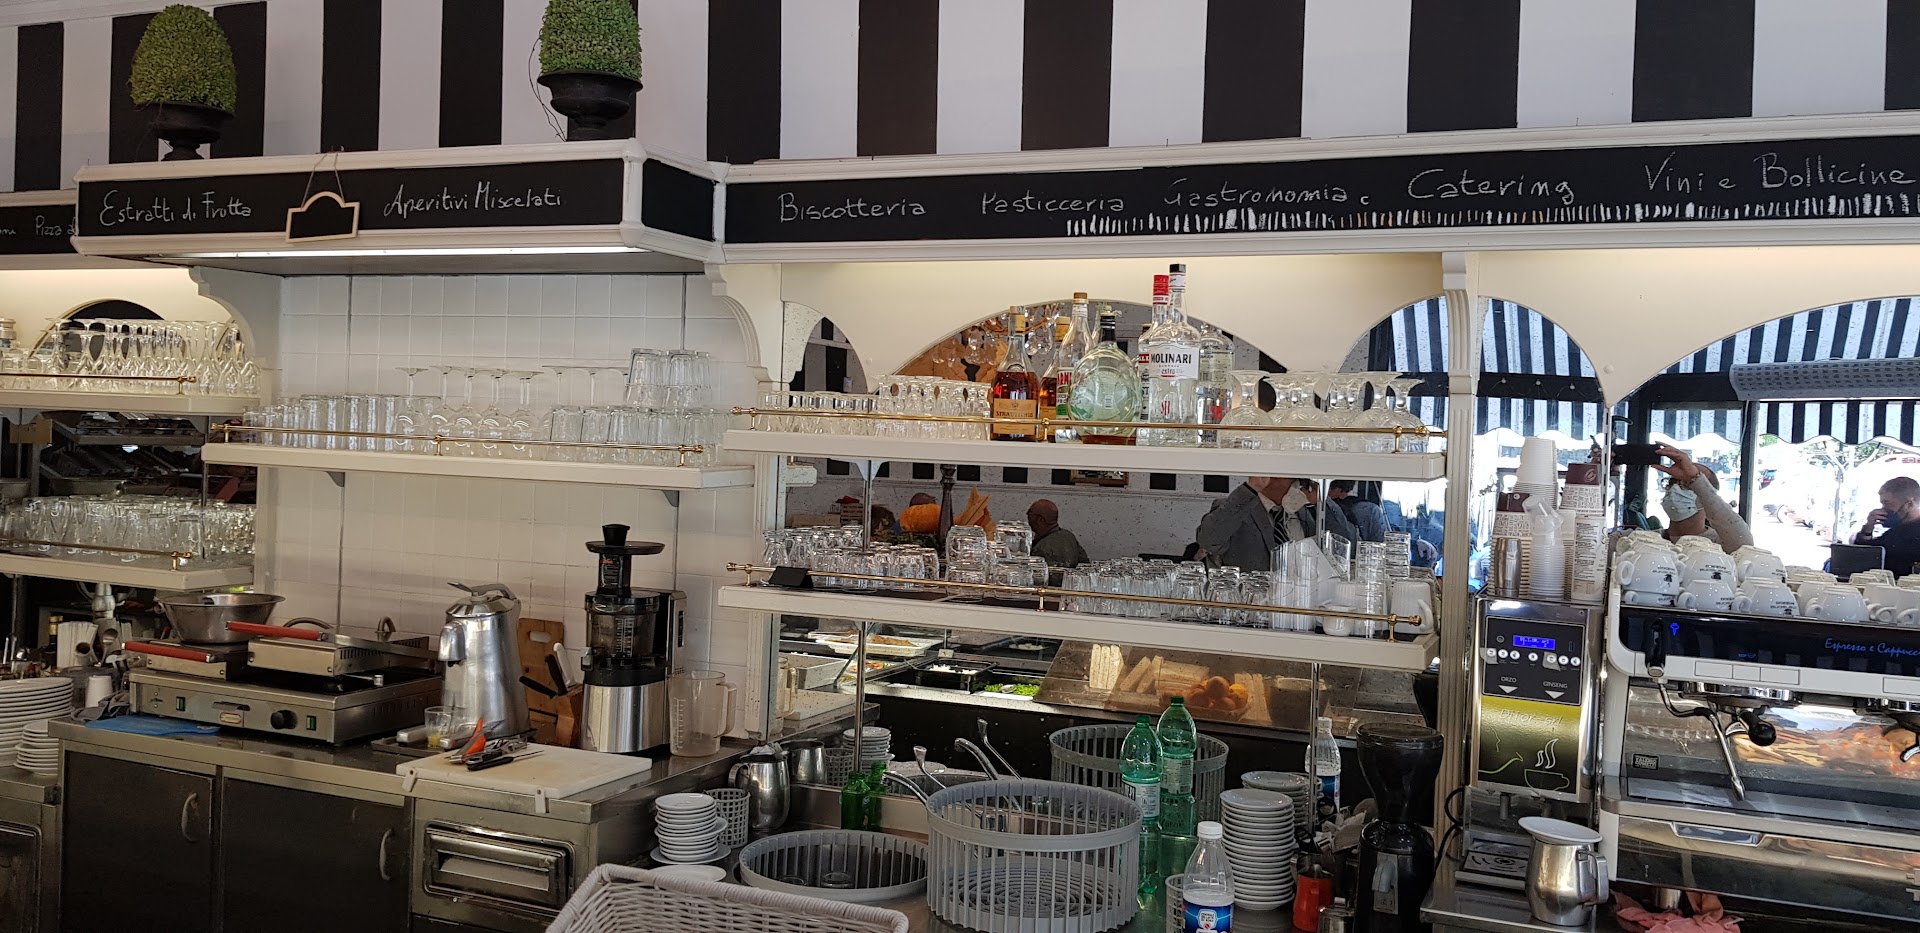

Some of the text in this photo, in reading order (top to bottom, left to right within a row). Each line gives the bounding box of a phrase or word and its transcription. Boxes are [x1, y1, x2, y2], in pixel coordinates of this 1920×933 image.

[1645, 152, 1916, 193] Vini e Bollicine
[100, 189, 251, 226] Estratti di Frutta
[384, 181, 561, 219] Aperitivi Miscelati
[778, 192, 926, 223] Biscotteria
[981, 189, 1125, 214] Pasticceria
[1408, 168, 1575, 205] Catering
[35, 215, 62, 236] Pizza
[1150, 353, 1192, 364] MOLINARI
[1824, 637, 1866, 653] Espresso
[1543, 681, 1568, 689] GINSENG
